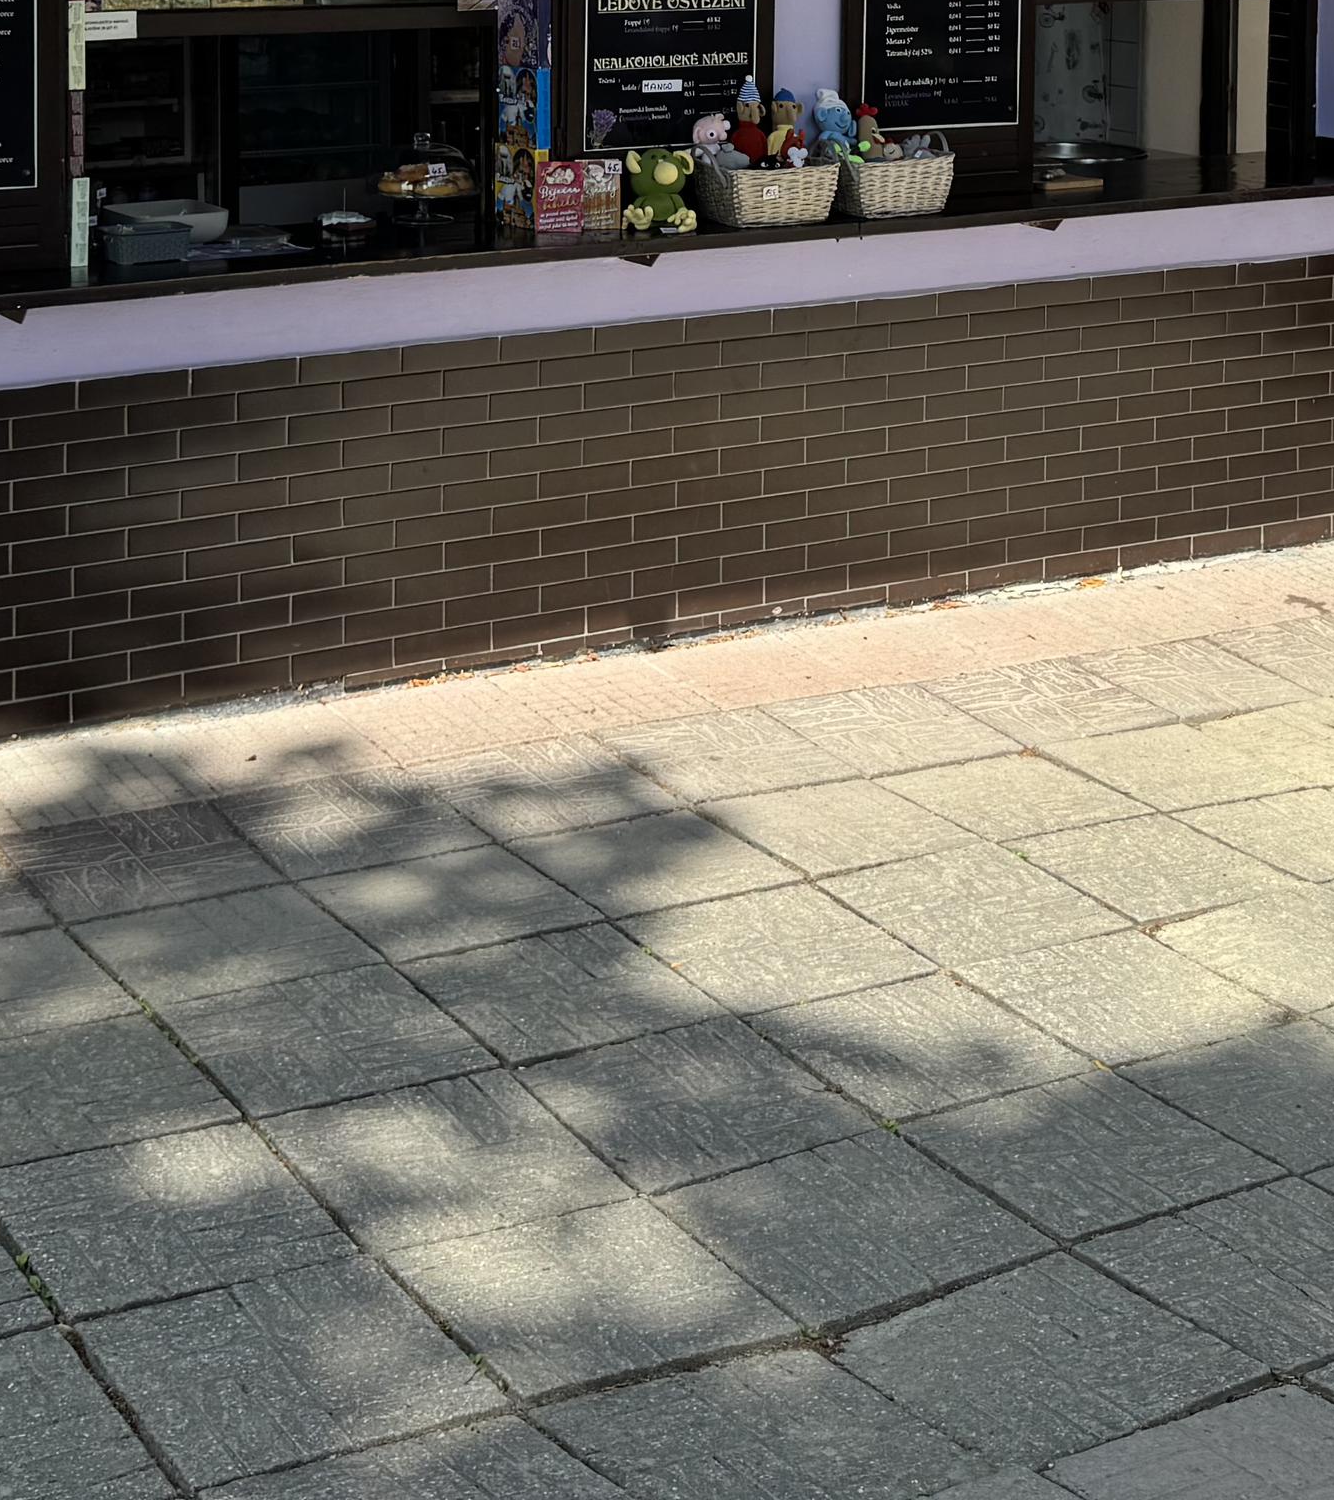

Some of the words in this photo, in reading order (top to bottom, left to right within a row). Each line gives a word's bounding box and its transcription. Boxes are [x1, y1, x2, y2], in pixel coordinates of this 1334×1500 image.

[593, 53, 699, 70] NEALKOHOLICKÉ
[702, 52, 748, 65] NÁPOJE
[644, 83, 673, 91] MANGO
